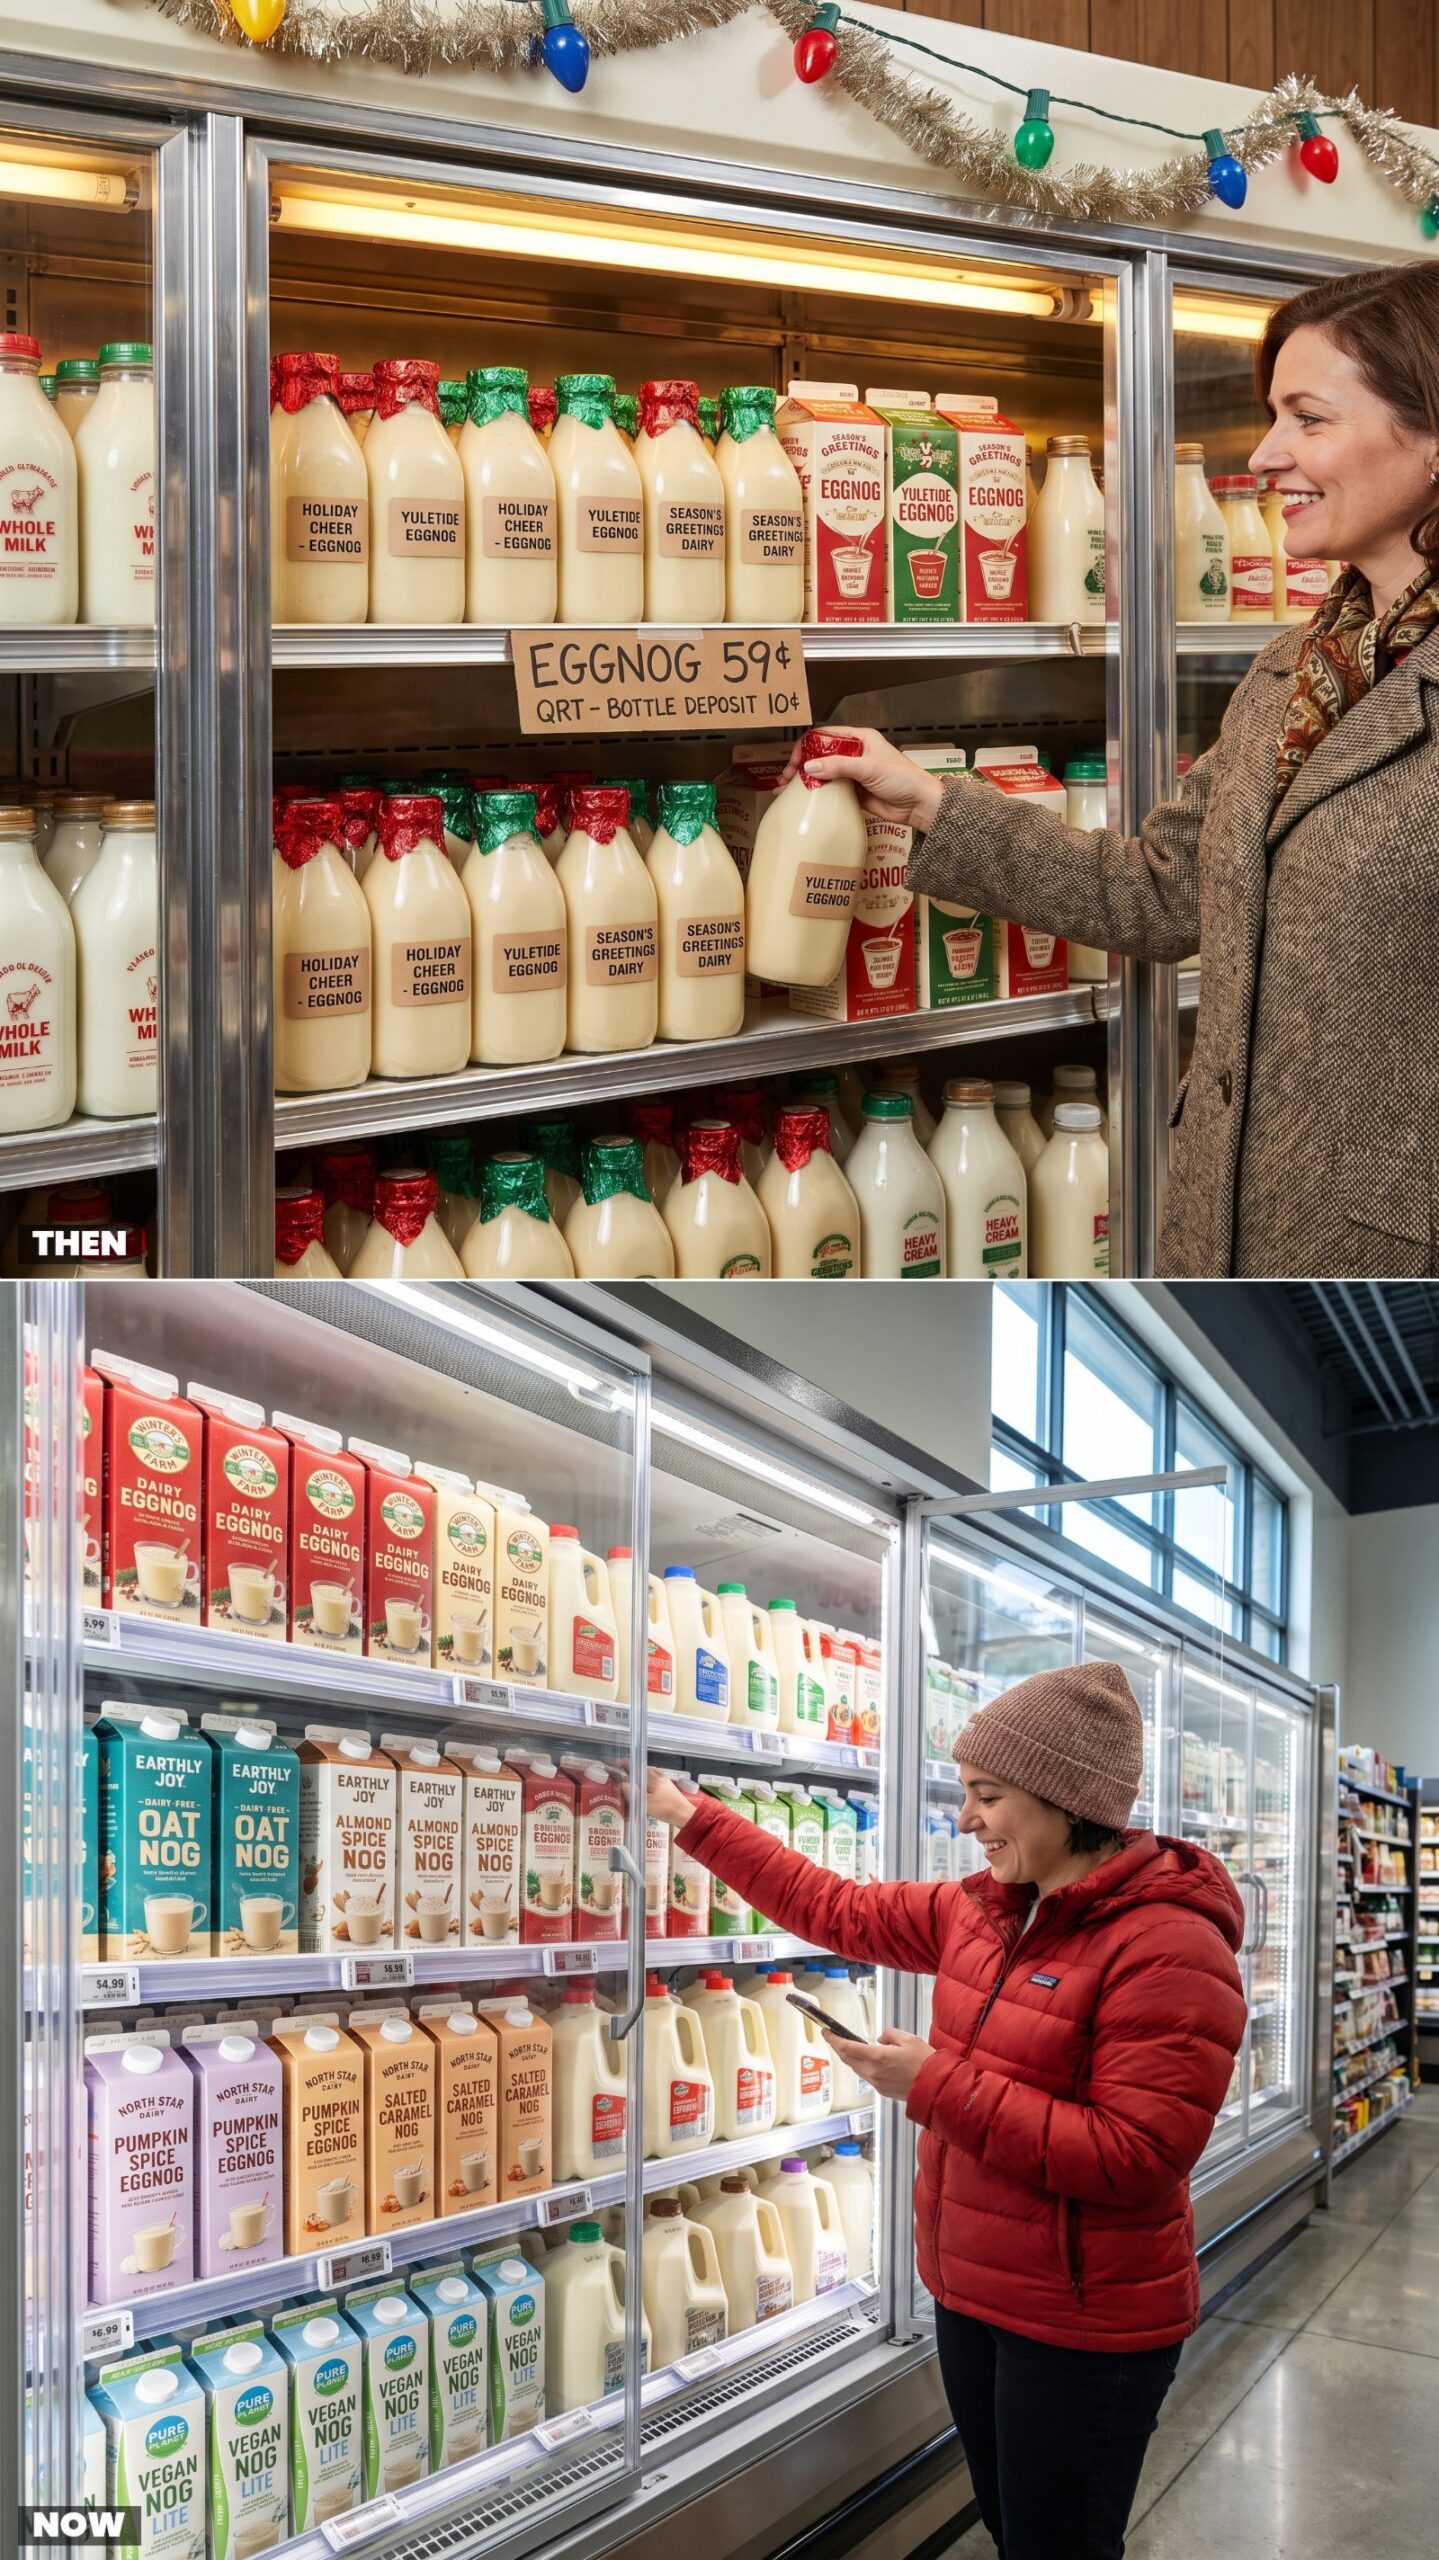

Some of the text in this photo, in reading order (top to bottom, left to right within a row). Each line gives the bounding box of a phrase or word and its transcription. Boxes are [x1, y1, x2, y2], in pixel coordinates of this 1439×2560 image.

[832, 434, 866, 442] SEASON'S
[822, 441, 880, 459] GREETINGS
[978, 444, 1010, 452] SEASON'S
[969, 450, 1022, 467] GREETINGS
[822, 480, 880, 500] EGGNOG
[902, 488, 951, 502] YULETIDE
[969, 487, 1023, 507] EGGNOG
[303, 503, 358, 517] HOLIDAY
[499, 503, 548, 516] HOLIDAY
[589, 510, 640, 523] YULETIDE
[670, 508, 722, 520] SEASON'S
[900, 503, 954, 522] EGGNOG
[402, 512, 459, 526] YULETIDE
[505, 520, 543, 532] CHEER
[753, 516, 801, 527] SEASON'S
[0, 521, 55, 535] WHOLE
[310, 522, 352, 535] CHEER
[406, 529, 456, 542] EGGNOG
[592, 527, 638, 539] EGGNOG
[666, 523, 723, 536] GREETINGS
[749, 530, 803, 542] GREETINGS
[5, 538, 46, 551] MILK
[309, 540, 361, 553] EGGNOG
[504, 537, 550, 550] EGGNOG
[682, 540, 714, 550] DAIRY
[764, 546, 794, 557] DAIRY
[530, 640, 791, 688] EGGNOG 59¢
[537, 698, 585, 723] QRT
[608, 697, 676, 719] BOTTLE
[685, 695, 757, 714] DEPOSIT
[769, 692, 800, 714] 10¢
[806, 876, 857, 892] YULETIDE
[806, 893, 850, 906] EGGNOG
[597, 928, 653, 944] SEASON'S
[688, 921, 740, 936] SEASON'S
[407, 945, 461, 961] HOLIDAY
[504, 944, 560, 960] YULETIDE
[592, 944, 656, 961] GREETINGS
[682, 937, 744, 952] GREETINGS
[302, 956, 359, 972] HOLIDAY
[509, 961, 558, 977] EGGNOG
[609, 962, 643, 976] DAIRY
[699, 954, 731, 968] DAIRY
[414, 963, 455, 978] CHEER
[310, 974, 352, 989] CHEER
[413, 979, 464, 996] EGGNOG
[308, 991, 362, 1008] EGGNOG
[0, 1040, 41, 1059] MILK
[986, 1215, 1018, 1231] HEAVY
[905, 1232, 936, 1250] HEAVY
[986, 1227, 1018, 1243] CREAM
[904, 1245, 937, 1261] CREAM
[136, 1420, 182, 1446] WINTER'S
[144, 1453, 177, 1469] FARM
[137, 1477, 182, 1498] DAIRY
[237, 1479, 266, 1495] FARM
[121, 1487, 197, 1522] EGGNOG
[232, 1503, 271, 1520] DAIRY
[318, 1502, 344, 1517] FARM
[216, 1512, 283, 1543] EGGNOG
[313, 1524, 348, 1539] DAIRY
[300, 1533, 360, 1562] EGGNOG
[387, 1544, 419, 1559] DAIRY
[375, 1552, 429, 1579] EGGNOG
[453, 1562, 482, 1577] DAIRY
[442, 1571, 490, 1594] EGGNOG
[512, 1577, 538, 1591] DAIRY
[502, 1586, 546, 1608] EGGNOG
[136, 1755, 202, 1774] EARTHLY
[232, 1764, 291, 1782] EARTHLY
[155, 1772, 185, 1788] JOY
[249, 1780, 276, 1794] JOY
[338, 1775, 390, 1790] EARTHLY
[410, 1781, 456, 1796] EARTHLY
[353, 1790, 375, 1803] JOY
[474, 1787, 516, 1800] EARTHLY
[424, 1797, 444, 1808] JOY
[486, 1801, 504, 1812] JOY
[138, 1810, 200, 1839] OAT
[235, 1815, 289, 1842] OAT
[336, 1815, 392, 1830] ALMOND
[408, 1820, 458, 1834] ALMOND
[472, 1823, 518, 1837] ALMOND
[342, 1832, 386, 1847] SPICE
[414, 1835, 454, 1850] SPICE
[477, 1838, 513, 1852] SPICE
[140, 1840, 200, 1866] NOG
[236, 1844, 289, 1869] NOG
[344, 1850, 386, 1870] NOG
[415, 1852, 453, 1871] NOG
[479, 1854, 512, 1872] NOG
[96, 1978, 124, 1990] $4.99
[382, 2060, 429, 2079] NORTH STAR
[512, 2069, 545, 2087] SALTED
[305, 2070, 357, 2089] NORTH STAR
[216, 2083, 275, 2102] NORTH STAR
[453, 2079, 490, 2098] SALTED
[506, 2083, 549, 2102] CARAMEL
[118, 2096, 184, 2117] NORTH STAR
[235, 2095, 258, 2104] DAIRY
[385, 2089, 426, 2108] SALTED
[447, 2094, 495, 2114] CARAMEL
[140, 2110, 164, 2119] DAIRY
[303, 2099, 360, 2122] PUMPKIN
[379, 2104, 432, 2125] CARAMEL
[520, 2100, 539, 2115] NOG
[213, 2113, 278, 2138] PUMPKIN
[461, 2111, 482, 2127] NOG
[314, 2118, 350, 2138] SPICE
[395, 2122, 418, 2139] NOG
[115, 2128, 188, 2155] PUMPKIN
[226, 2133, 267, 2153] SPICE
[306, 2134, 357, 2156] EGGNOG
[129, 2149, 175, 2171] SPICE
[218, 2149, 275, 2174] EGGNOG
[120, 2166, 183, 2193] EGGNOG
[93, 2325, 118, 2338] $6.99
[505, 2326, 541, 2351] VEGAN
[386, 2342, 413, 2358] PURE
[509, 2345, 537, 2371] NOG
[443, 2347, 483, 2375] VEGAN
[317, 2364, 346, 2382] PURE
[449, 2367, 479, 2395] NOG
[514, 2368, 535, 2386] LITE
[379, 2370, 423, 2399] VEGAN
[237, 2393, 270, 2412] PURE
[385, 2390, 419, 2420] NOG
[454, 2390, 476, 2410] LITE
[308, 2395, 356, 2426] VEGAN
[314, 2416, 351, 2448] NOG
[390, 2412, 416, 2435] LITE
[148, 2422, 186, 2444] PURE
[229, 2423, 281, 2457] VEGAN
[319, 2440, 348, 2465] LITE
[235, 2446, 277, 2481] NOG
[139, 2455, 198, 2492] VEGAN
[240, 2472, 273, 2499] LITE
[146, 2479, 192, 2516] NOG
[152, 2506, 188, 2535] LITE
